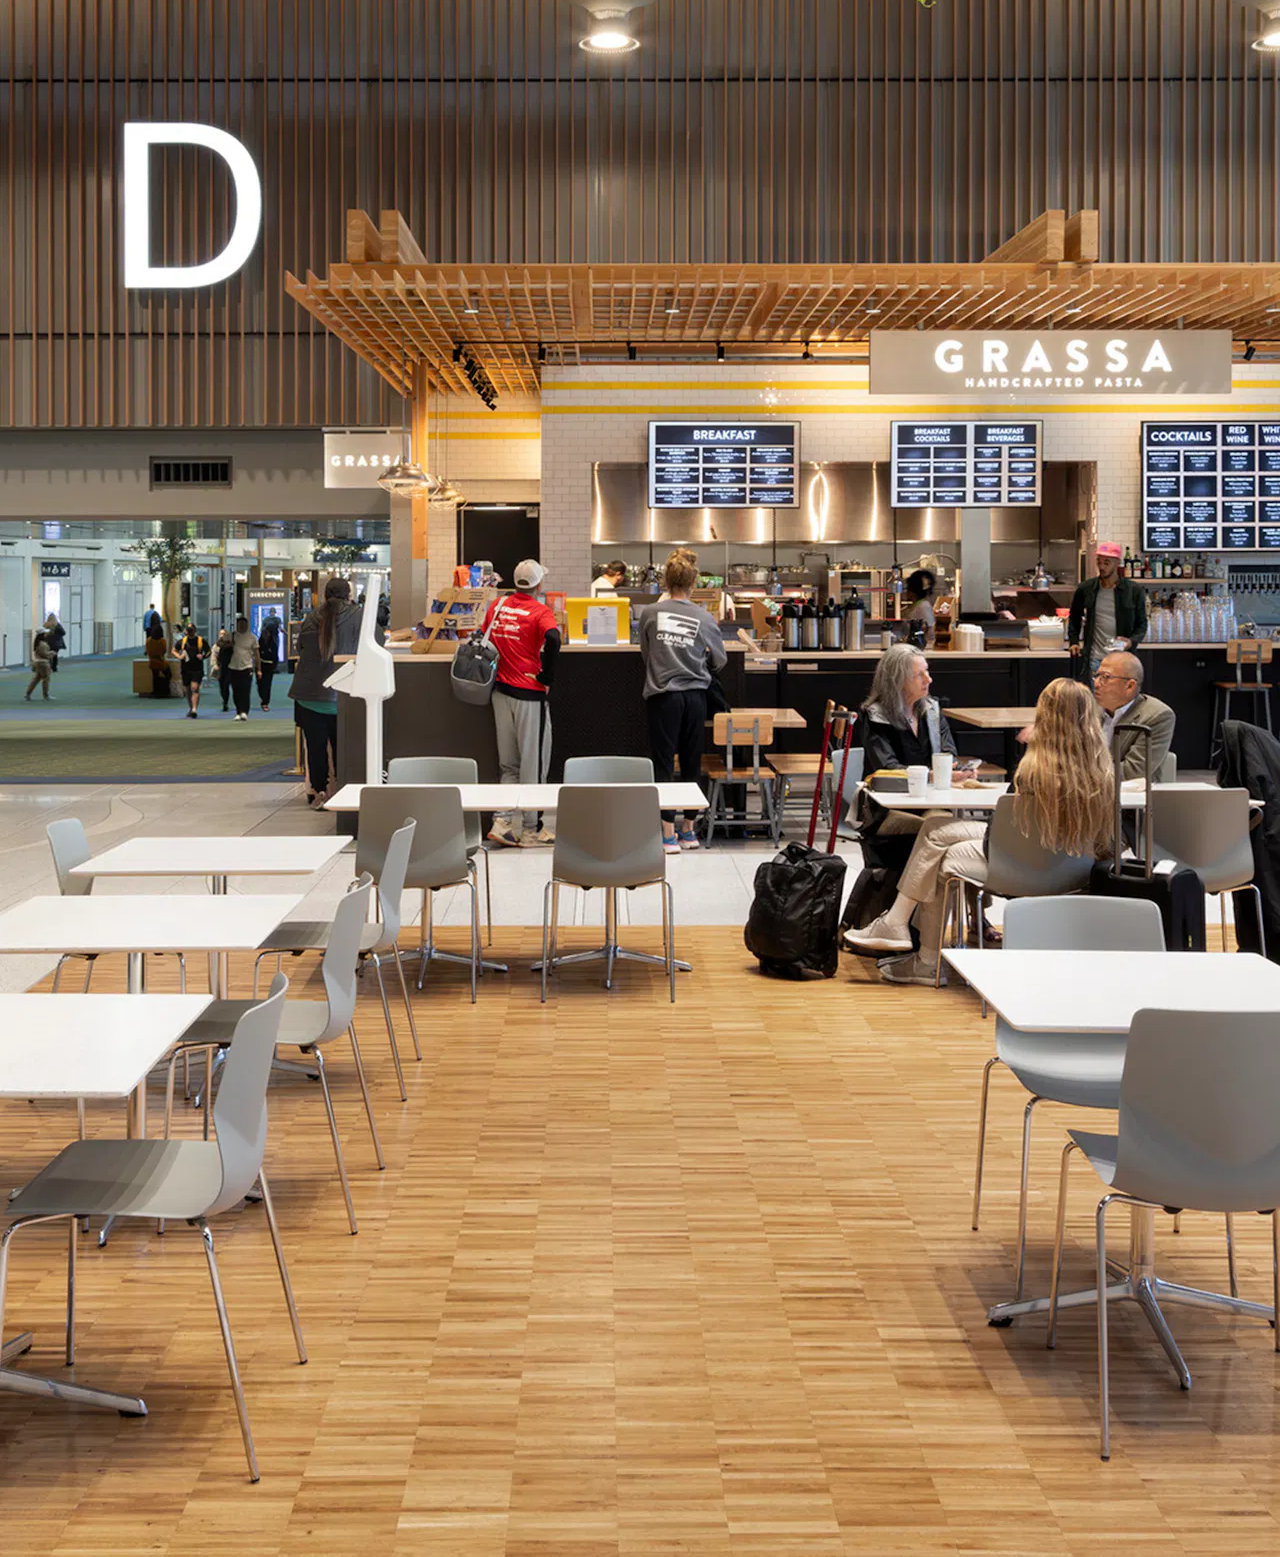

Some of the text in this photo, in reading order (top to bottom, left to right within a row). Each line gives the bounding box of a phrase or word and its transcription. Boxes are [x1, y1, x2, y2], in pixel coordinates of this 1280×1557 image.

[123, 122, 262, 289] D
[933, 338, 1173, 374] GRASSA
[965, 377, 1144, 388] HANDCRAFTED PASTA
[692, 429, 757, 441] BREAKFAST
[913, 427, 952, 436] BREAKFAST
[987, 427, 1025, 435] BREAKFAST
[1228, 425, 1247, 435] RED
[913, 435, 951, 443] COCKTAILS
[986, 434, 1025, 442] BEVERAGES
[1150, 431, 1212, 442] COCKTAILS
[1225, 435, 1250, 444] WINE
